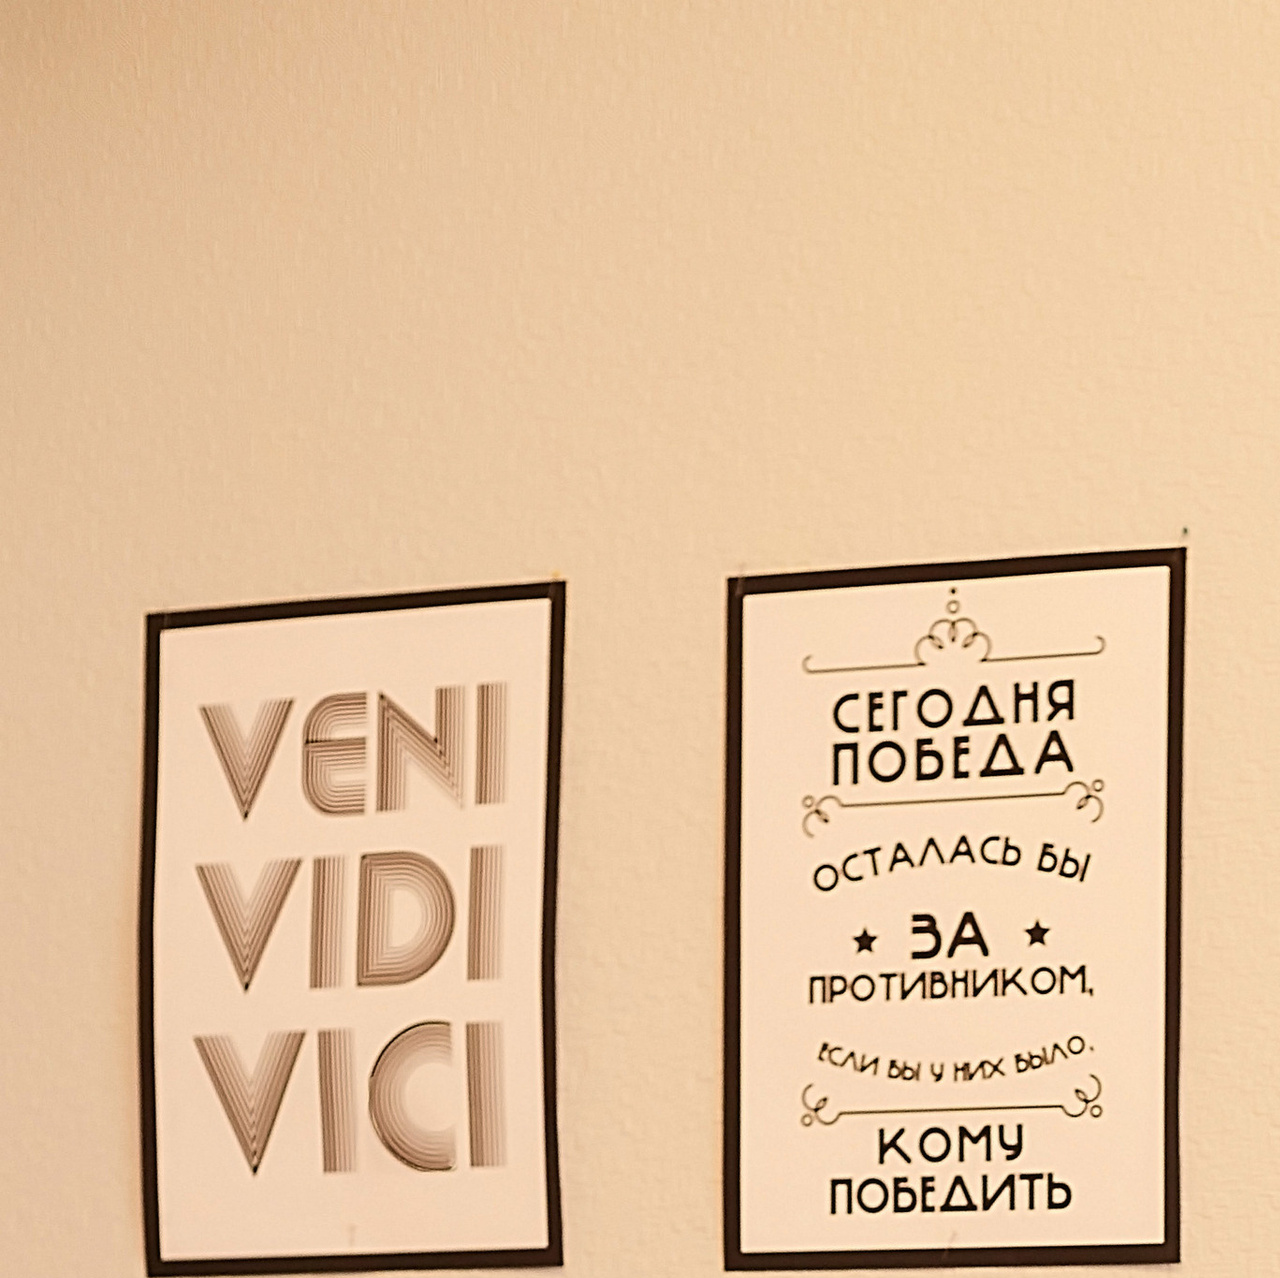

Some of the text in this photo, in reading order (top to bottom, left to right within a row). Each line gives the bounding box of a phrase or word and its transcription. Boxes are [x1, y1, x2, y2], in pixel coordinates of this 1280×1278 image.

[832, 679, 1076, 734] СЕГОДНЯ
[199, 682, 508, 822] VENI
[832, 730, 1074, 786] ПОБЕДА
[812, 835, 1092, 892] ОСТАЛАСЬ БЫ
[195, 844, 504, 994] VIDI
[910, 911, 990, 961] ЗА
[808, 964, 1095, 1005] ПРОТИВНИКОМ,
[817, 1042, 880, 1076] ЕСЛИ
[886, 1058, 922, 1082] БЫ
[953, 1057, 1007, 1083] НИХ
[193, 1019, 506, 1177] VICI
[877, 1123, 1025, 1166] КОМУ
[829, 1171, 1073, 1216] ПОБЕДИТЬ
